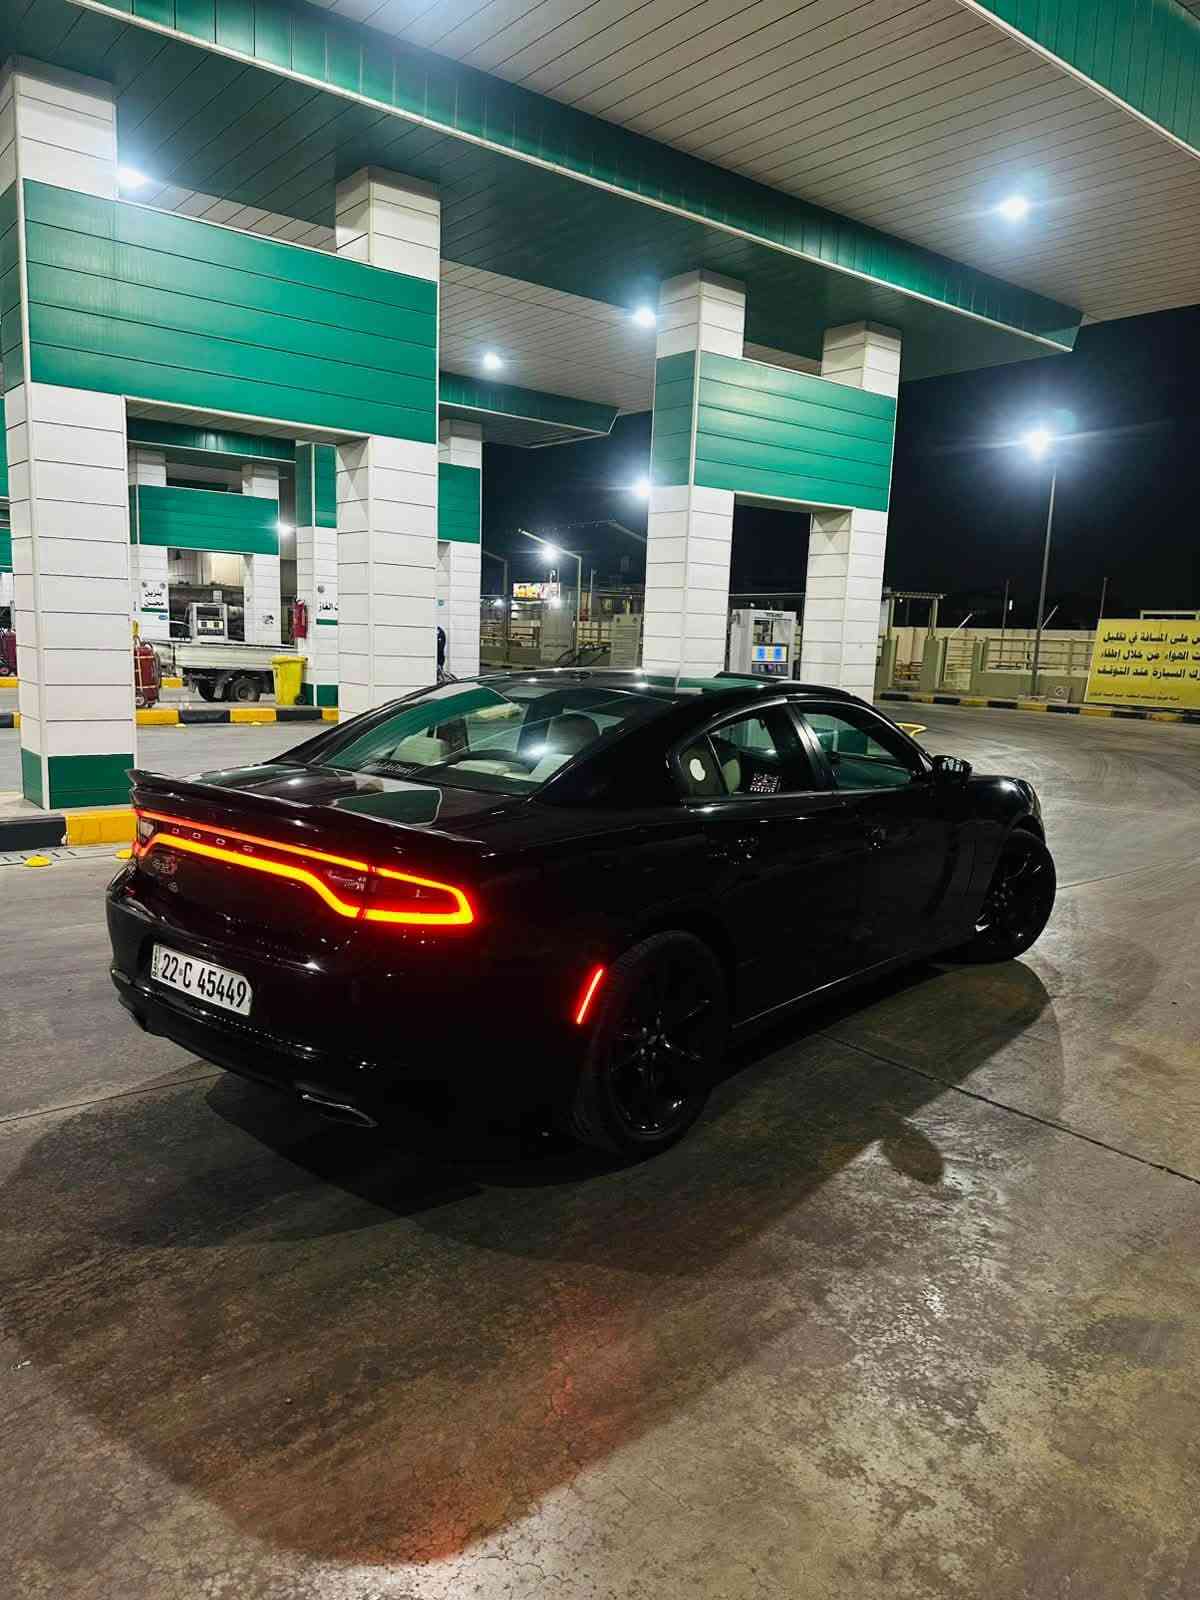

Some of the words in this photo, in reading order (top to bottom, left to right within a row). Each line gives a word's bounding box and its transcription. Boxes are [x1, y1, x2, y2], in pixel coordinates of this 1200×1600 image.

[162, 954, 178, 983] 22
[183, 962, 192, 988] C
[198, 968, 247, 1008] 45449
